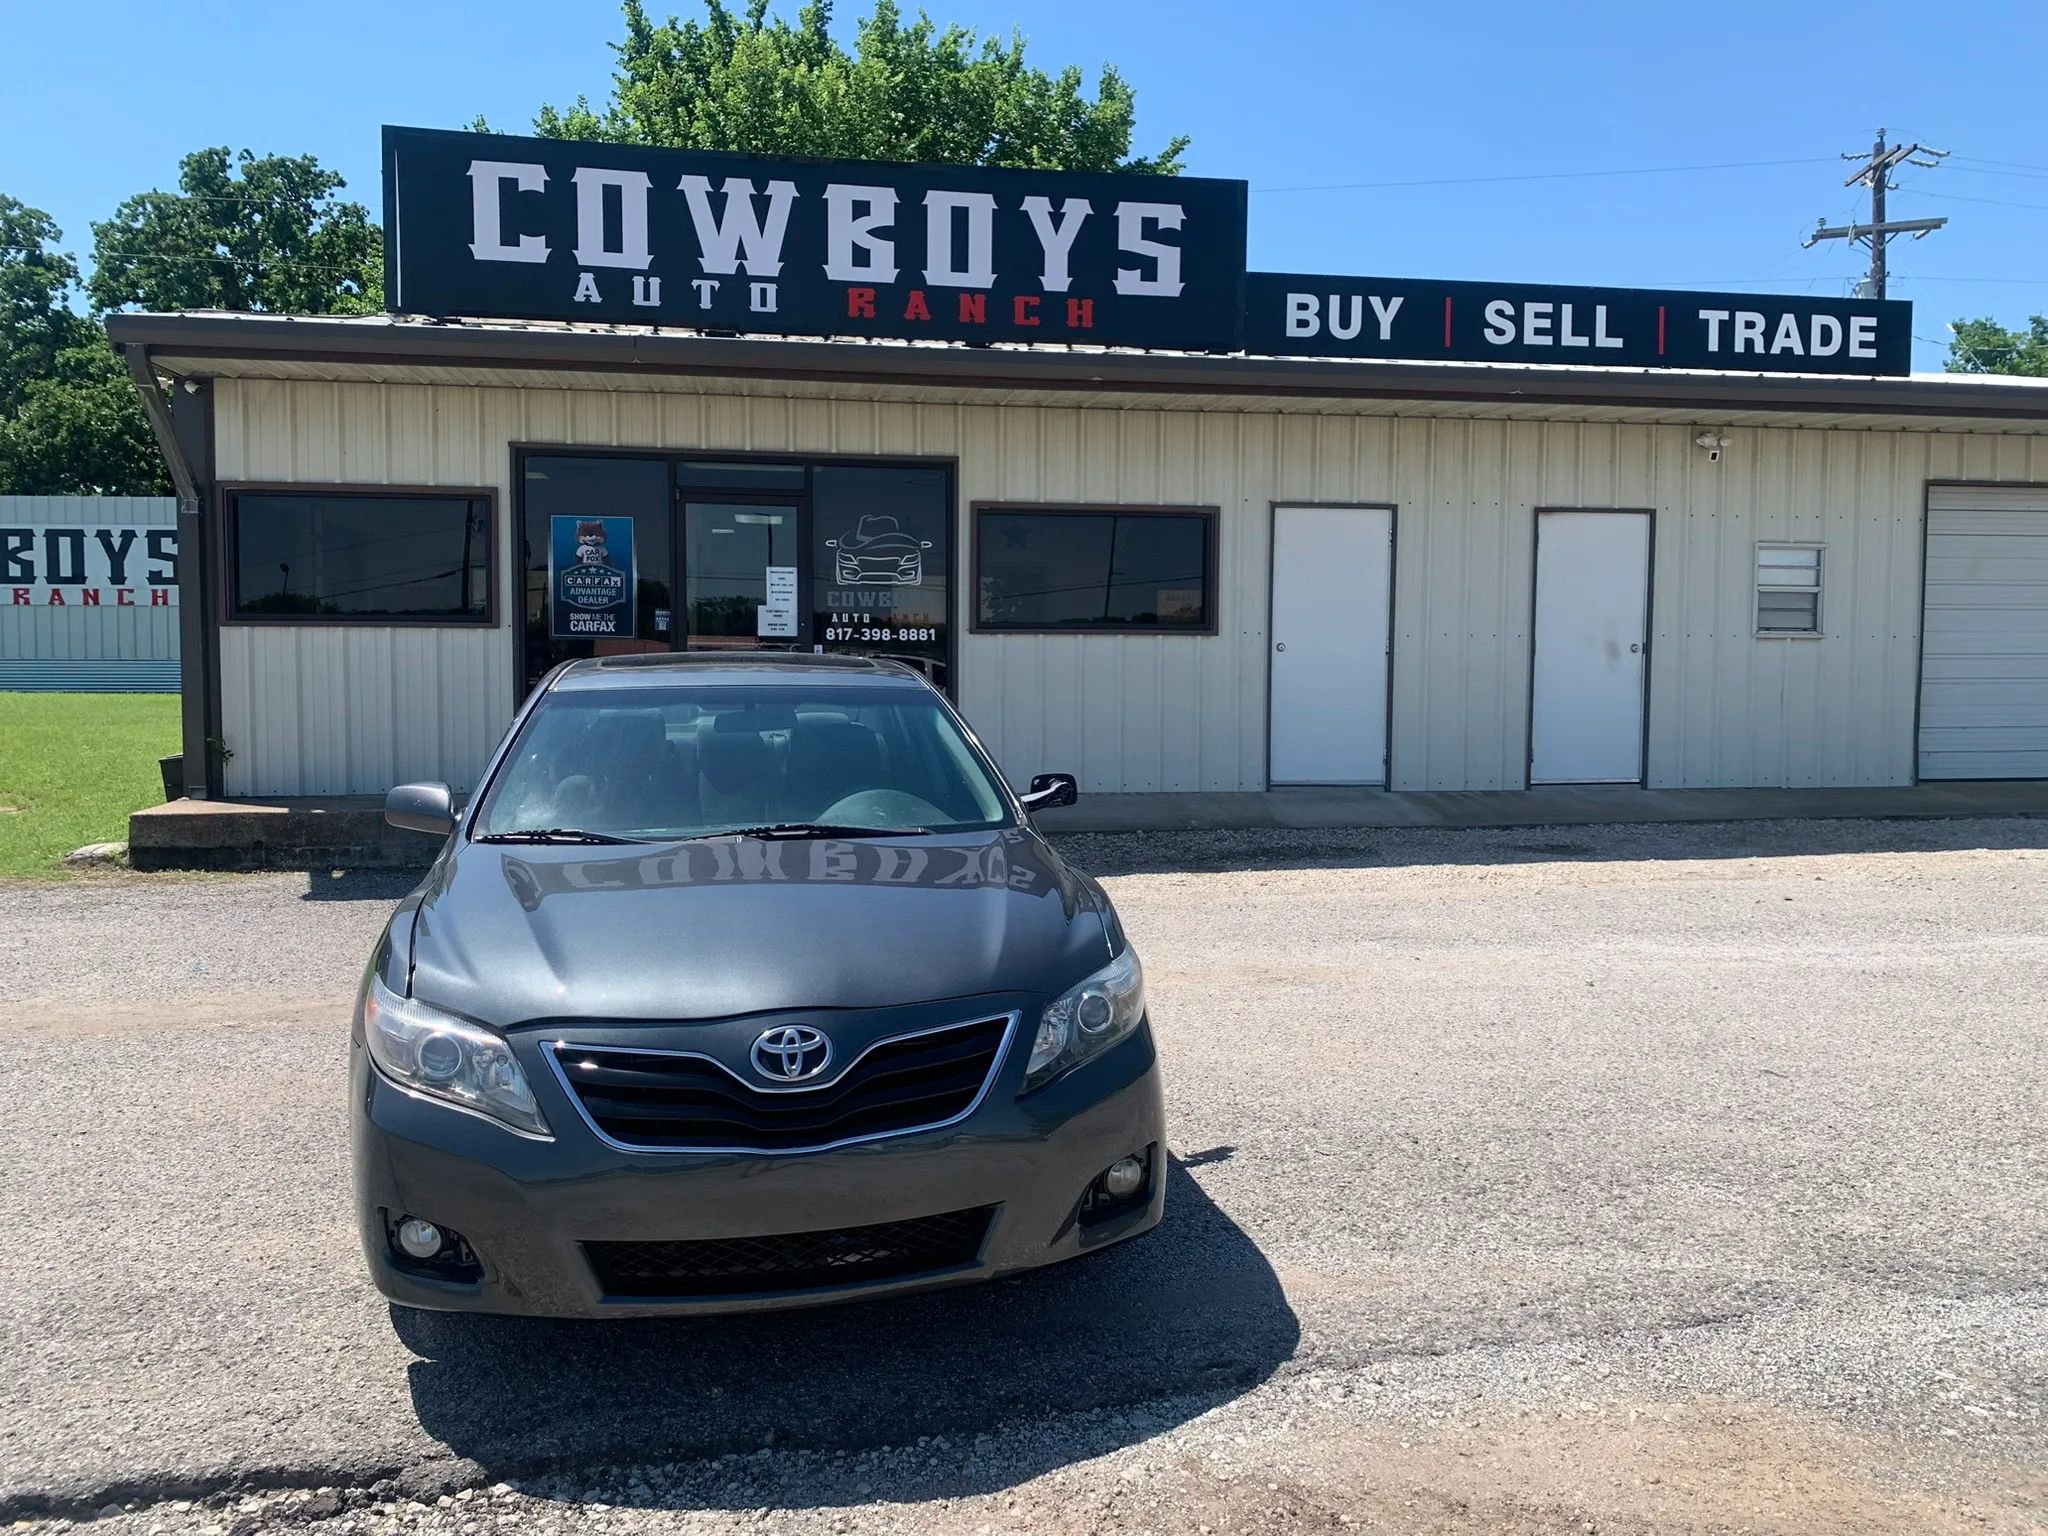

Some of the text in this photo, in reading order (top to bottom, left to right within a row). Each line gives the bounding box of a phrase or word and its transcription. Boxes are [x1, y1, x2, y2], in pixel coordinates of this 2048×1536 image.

[467, 159, 1187, 298] COWBOYS
[572, 272, 1095, 328] AUTO RANCH
[1285, 292, 1879, 359] BUY SELL TRADE
[566, 577, 621, 586] CARFAX
[12, 588, 169, 606] RANCH
[570, 587, 617, 596] ADVANTAGE
[578, 596, 609, 604] DEALER
[569, 612, 615, 621] SHOW ME THE
[831, 613, 870, 623] AUTO
[569, 620, 616, 632] CARFAX
[825, 627, 936, 641] 817-398-8881
